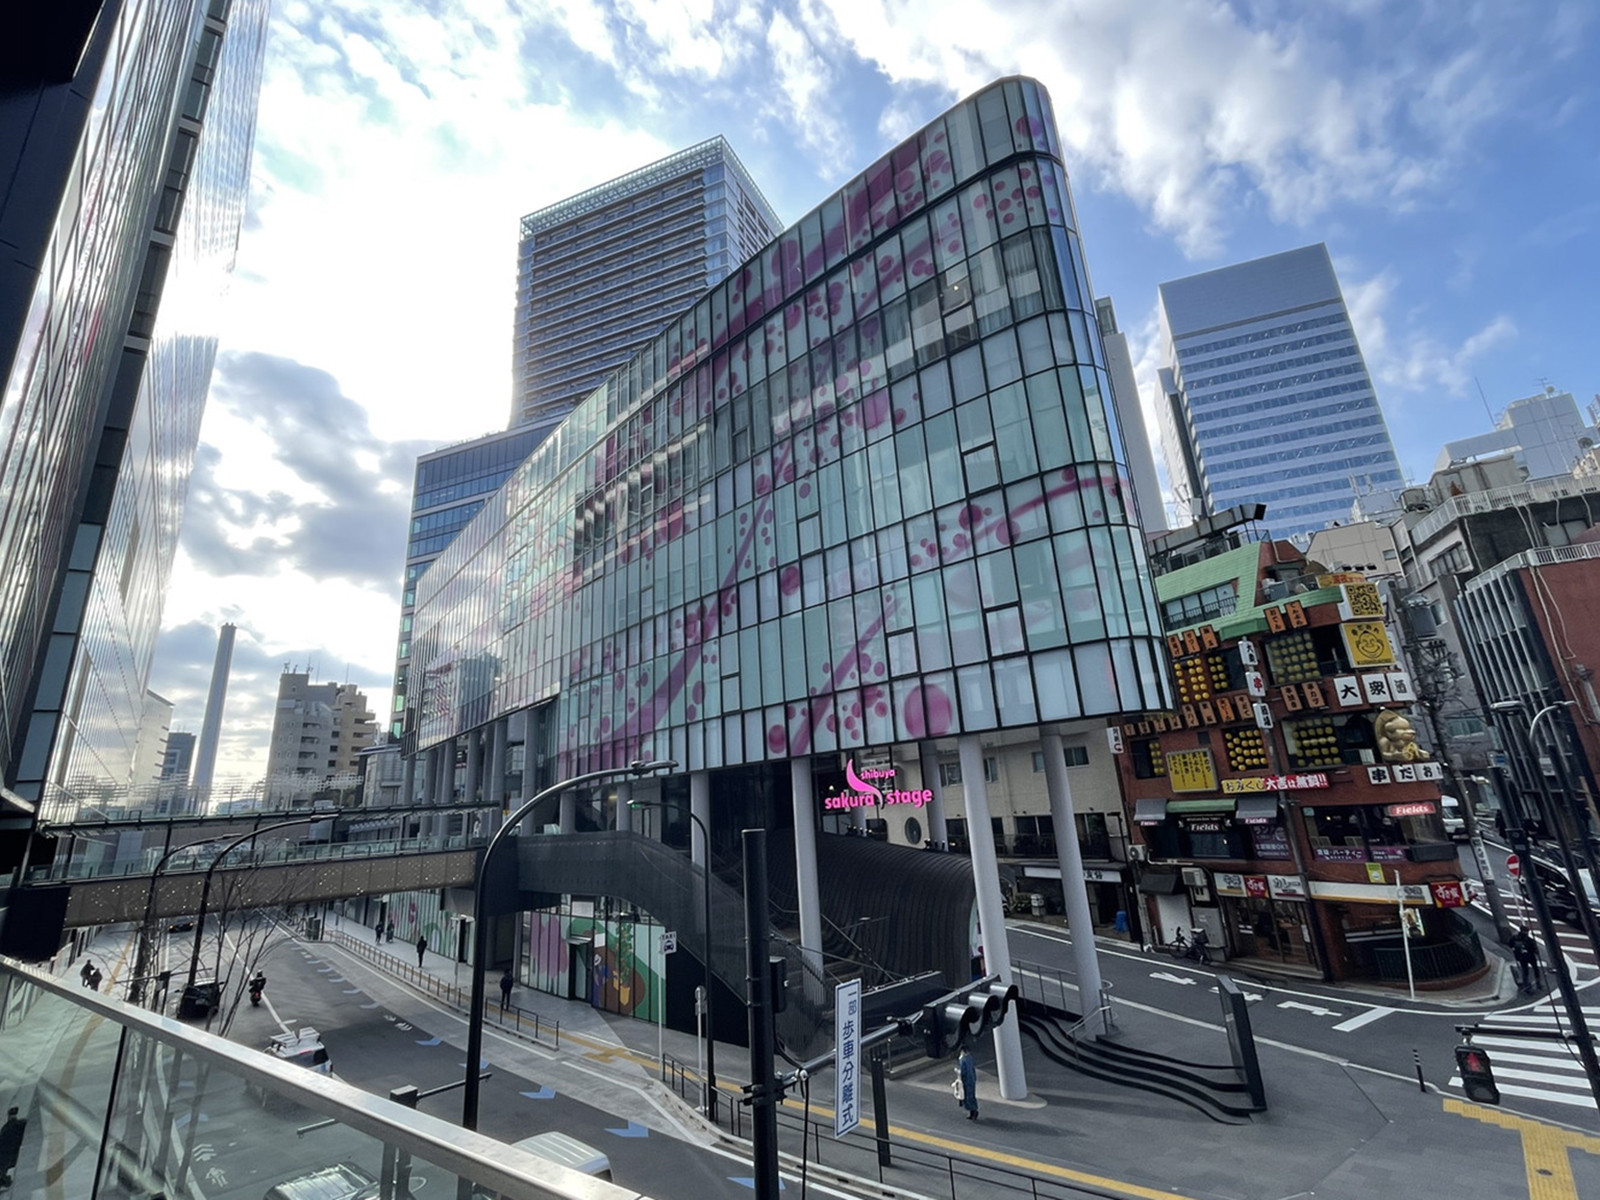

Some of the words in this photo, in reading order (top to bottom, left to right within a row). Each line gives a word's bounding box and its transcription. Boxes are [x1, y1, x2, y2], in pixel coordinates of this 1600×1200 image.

[860, 768, 896, 780] shibuya
[825, 792, 875, 809] sakura
[886, 788, 932, 808] stage
[1395, 805, 1429, 815] Fields
[1191, 823, 1220, 832] Fields
[1436, 885, 1460, 900] すき家
